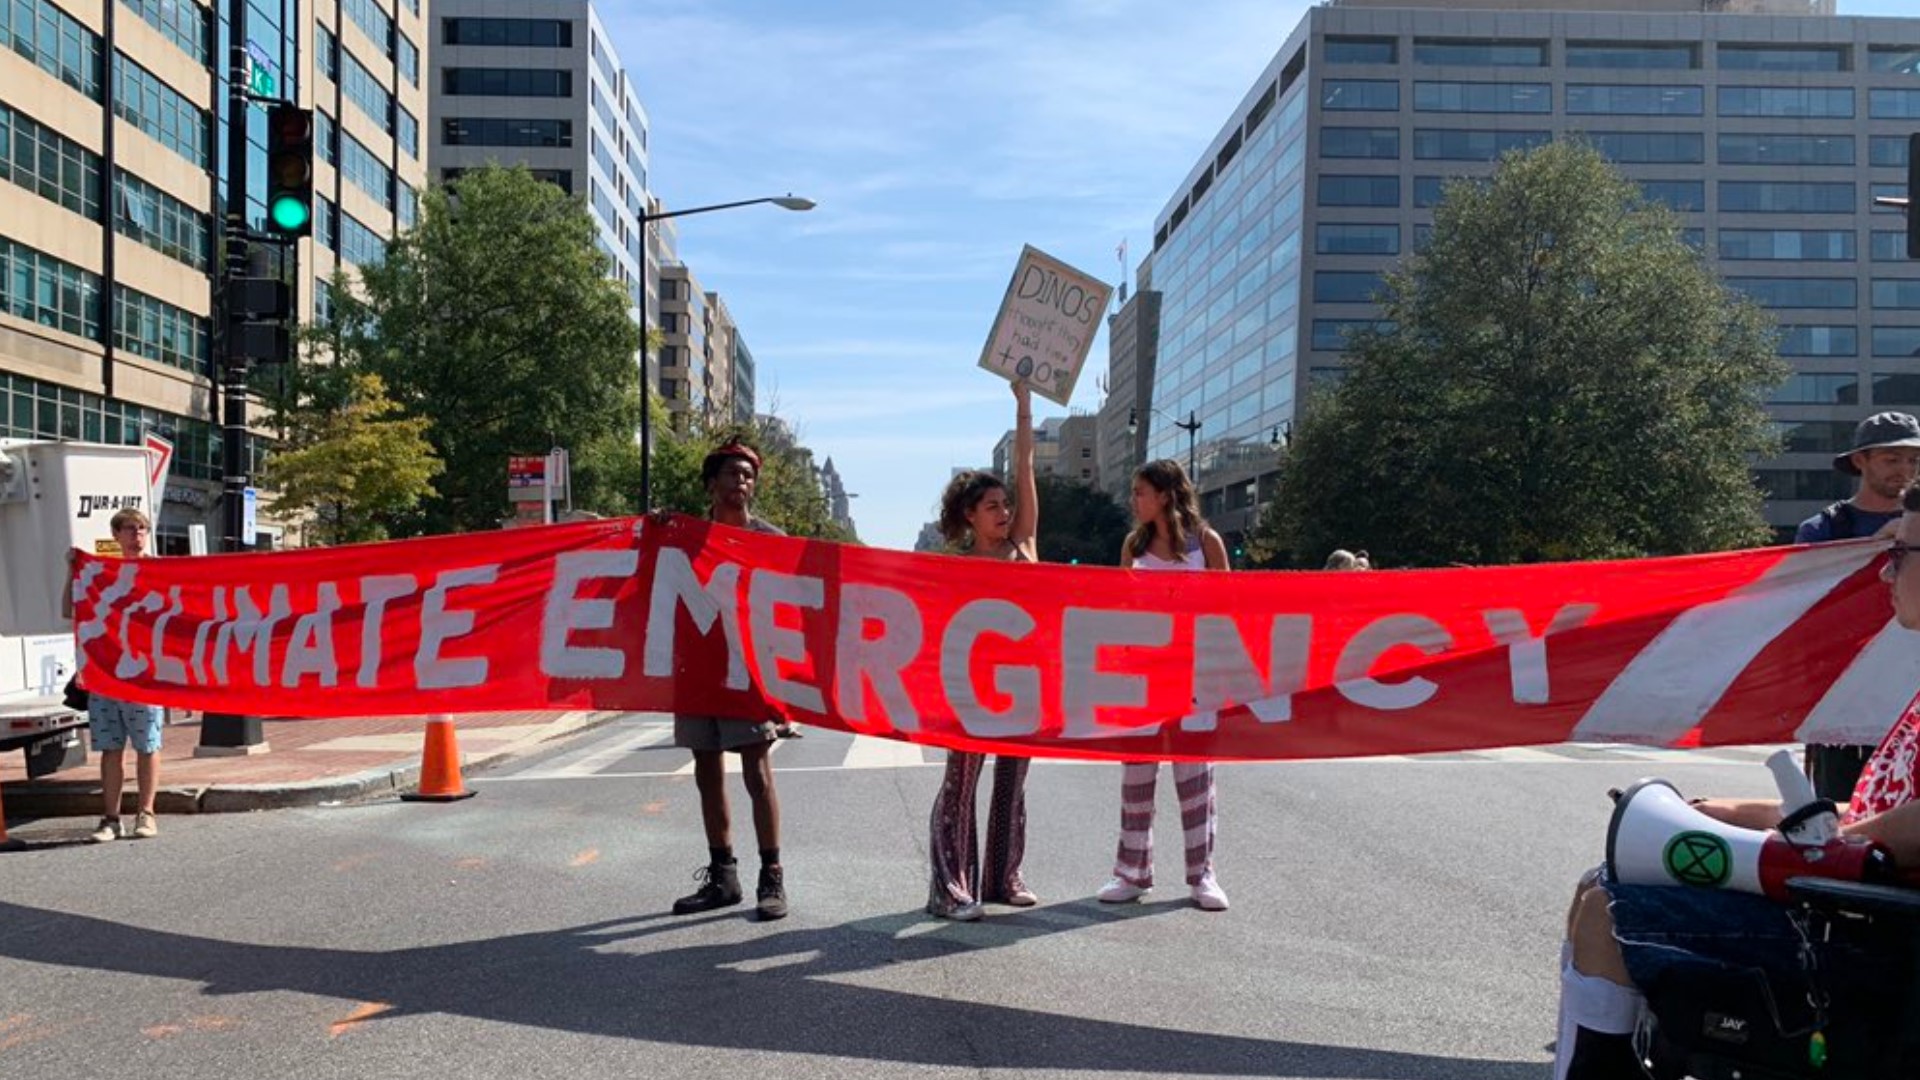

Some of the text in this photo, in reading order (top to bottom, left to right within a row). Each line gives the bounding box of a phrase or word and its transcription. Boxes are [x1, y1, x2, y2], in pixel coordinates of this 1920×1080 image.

[1017, 264, 1098, 324] DINOS
[115, 547, 1598, 738] CLIMATE EMERGENCY
[1720, 1017, 1746, 1030] JAY
